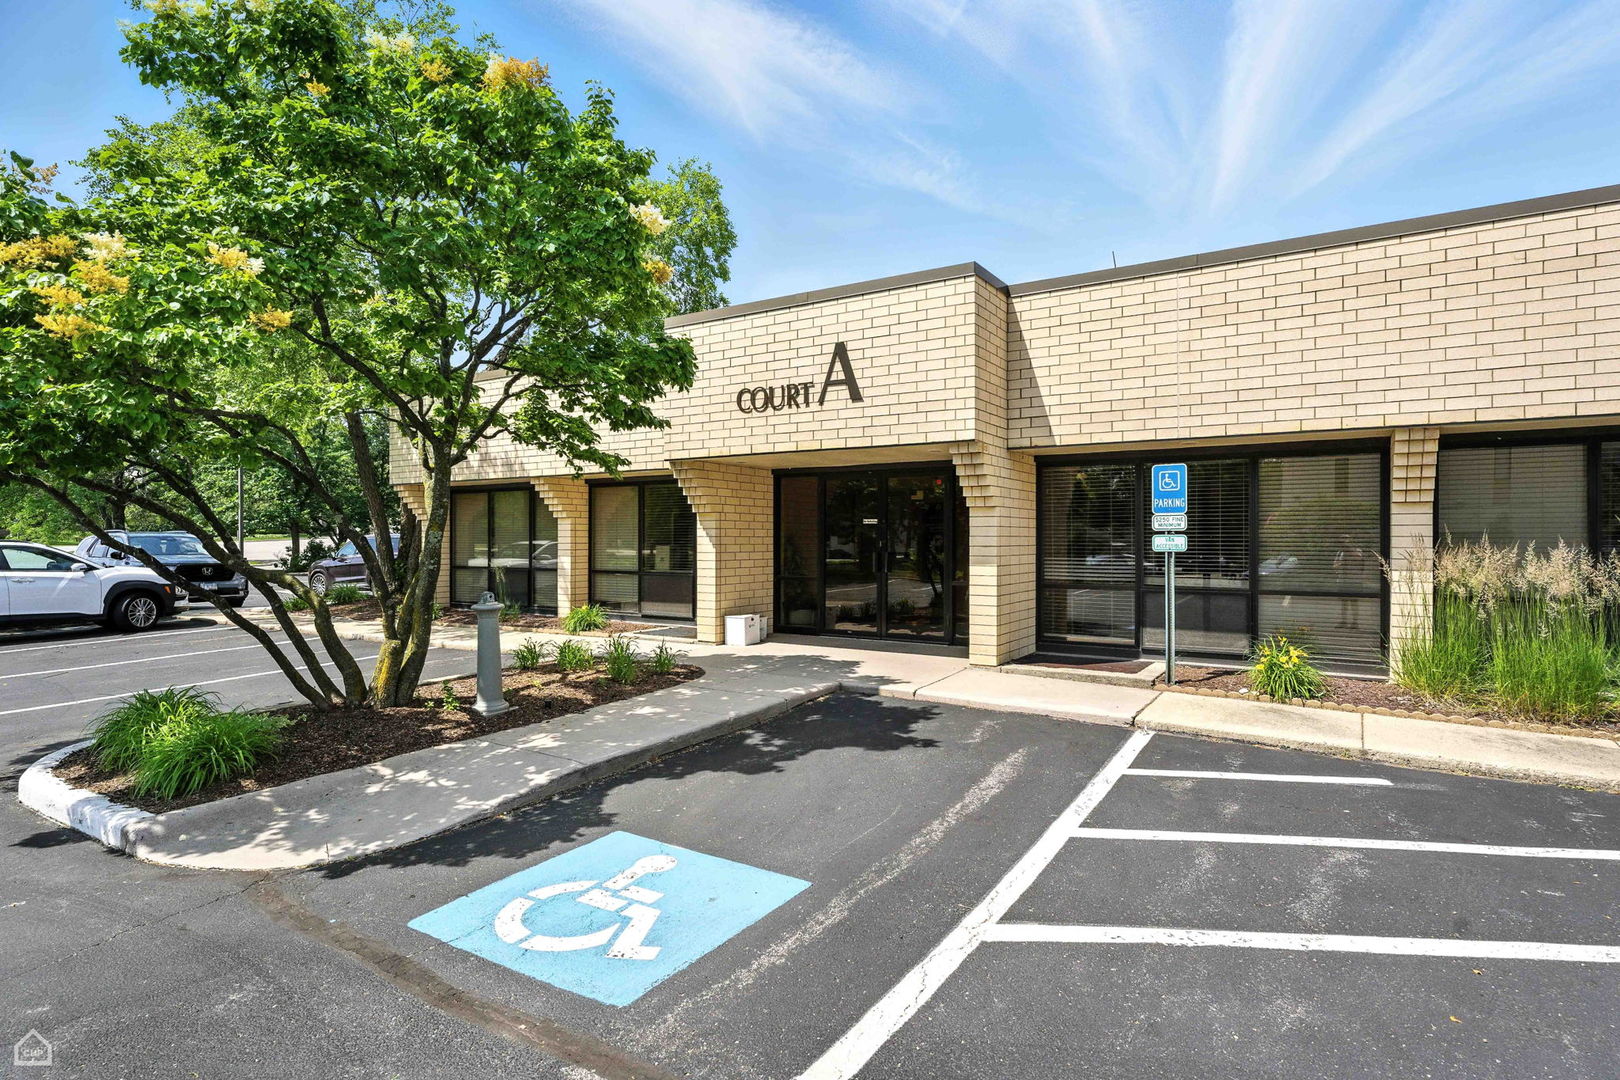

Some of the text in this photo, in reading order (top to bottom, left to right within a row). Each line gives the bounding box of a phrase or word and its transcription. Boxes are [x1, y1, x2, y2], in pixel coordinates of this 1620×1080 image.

[736, 341, 864, 414] COURT A
[1154, 498, 1185, 508] PARKING
